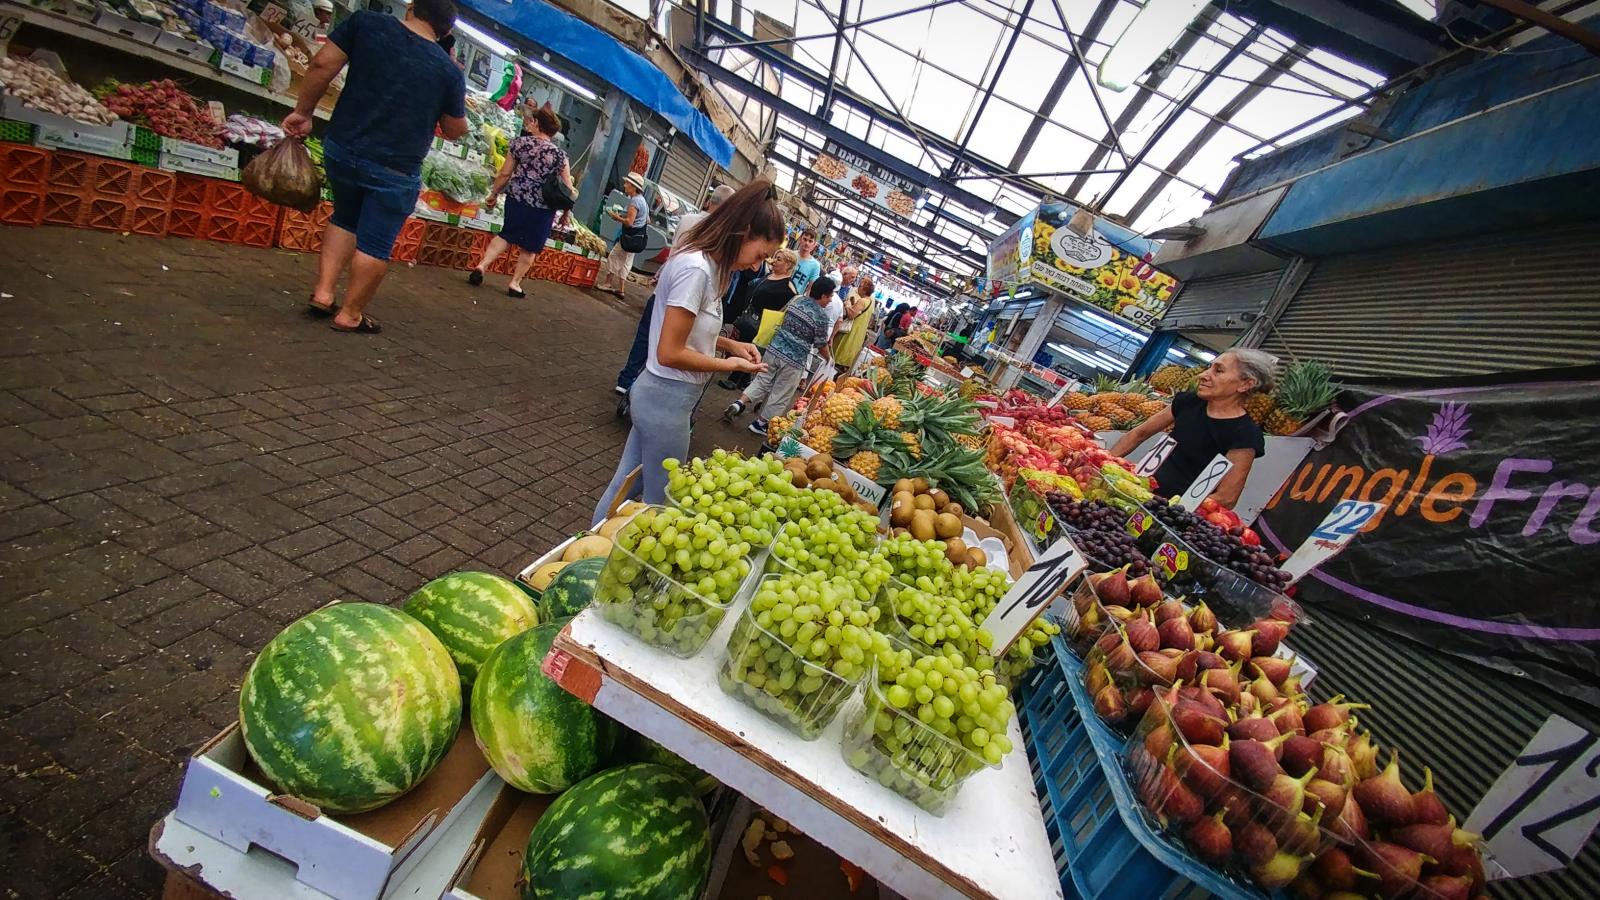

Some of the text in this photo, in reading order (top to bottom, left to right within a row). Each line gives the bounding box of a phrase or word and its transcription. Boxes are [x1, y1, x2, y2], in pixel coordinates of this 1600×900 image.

[1137, 435, 1176, 475] 15
[1190, 460, 1229, 499] 8
[1310, 501, 1377, 541] 22
